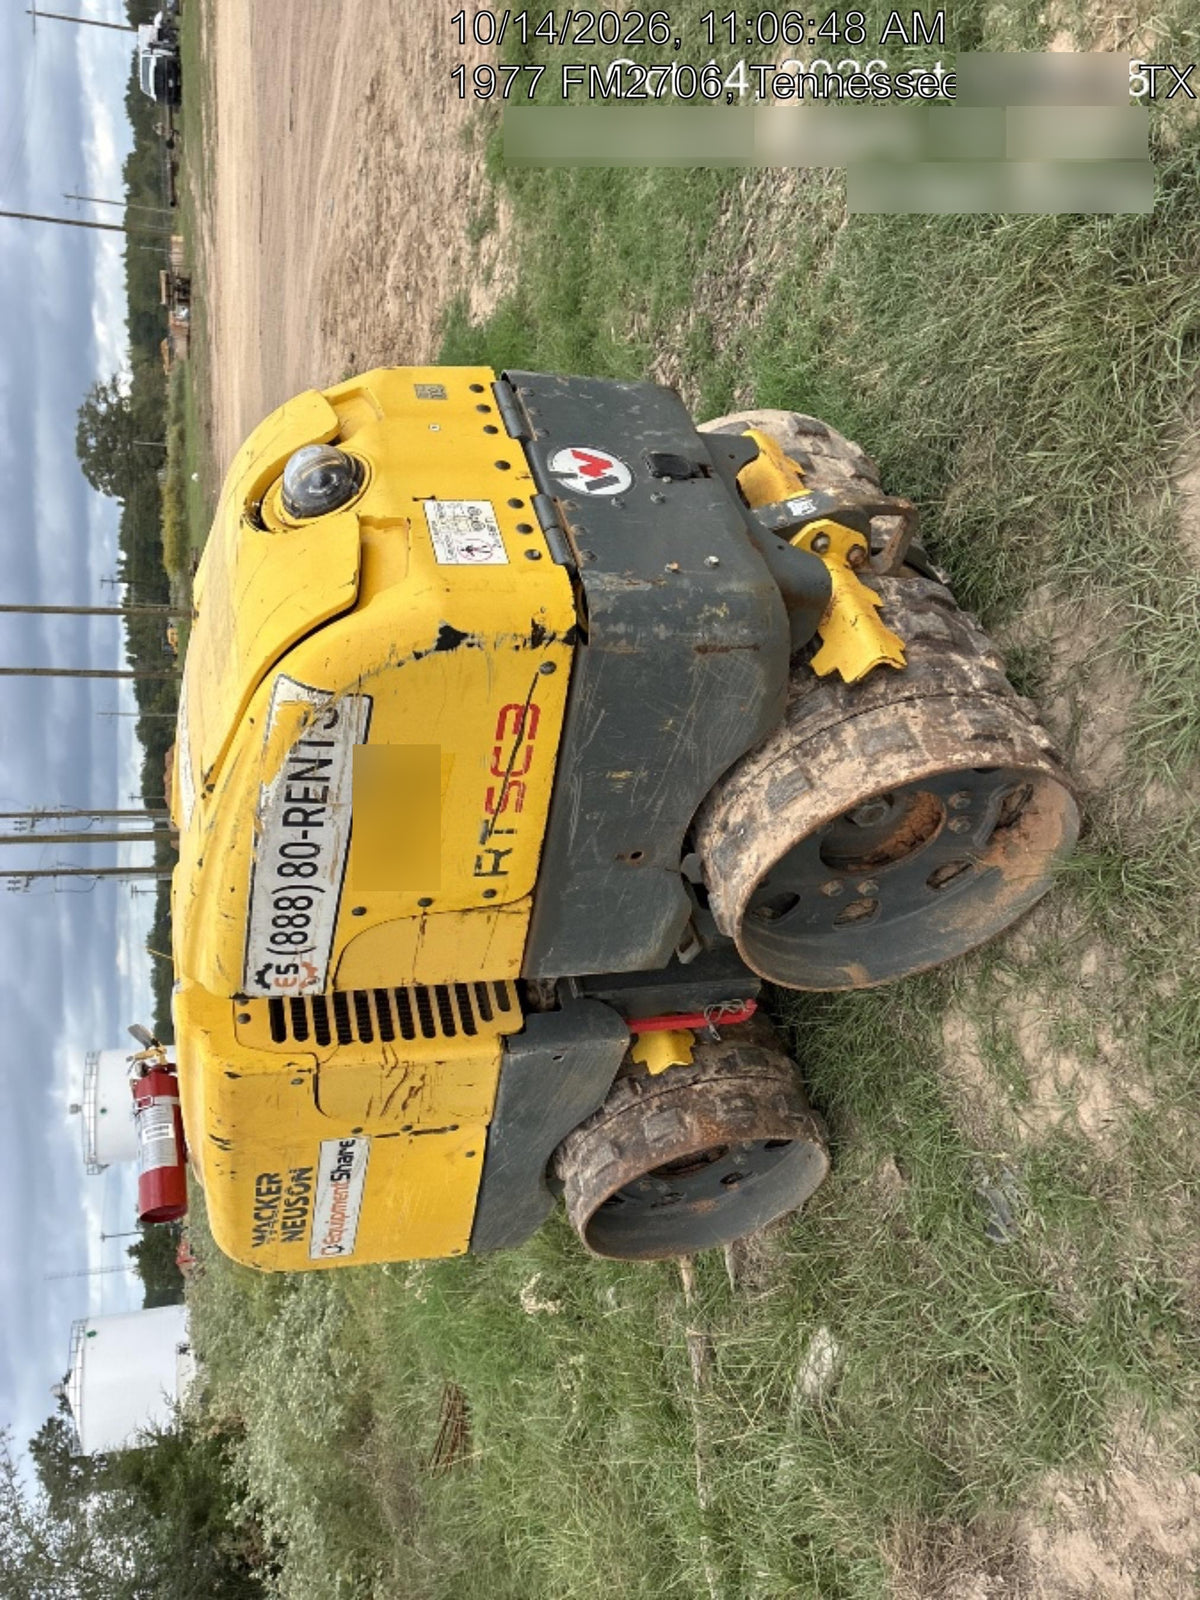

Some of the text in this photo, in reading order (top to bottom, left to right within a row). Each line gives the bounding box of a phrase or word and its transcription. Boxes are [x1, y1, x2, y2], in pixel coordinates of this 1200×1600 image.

[266, 885, 326, 955] (888)
[252, 1172, 282, 1248] WACKER
[281, 1166, 313, 1243] NEUSON
